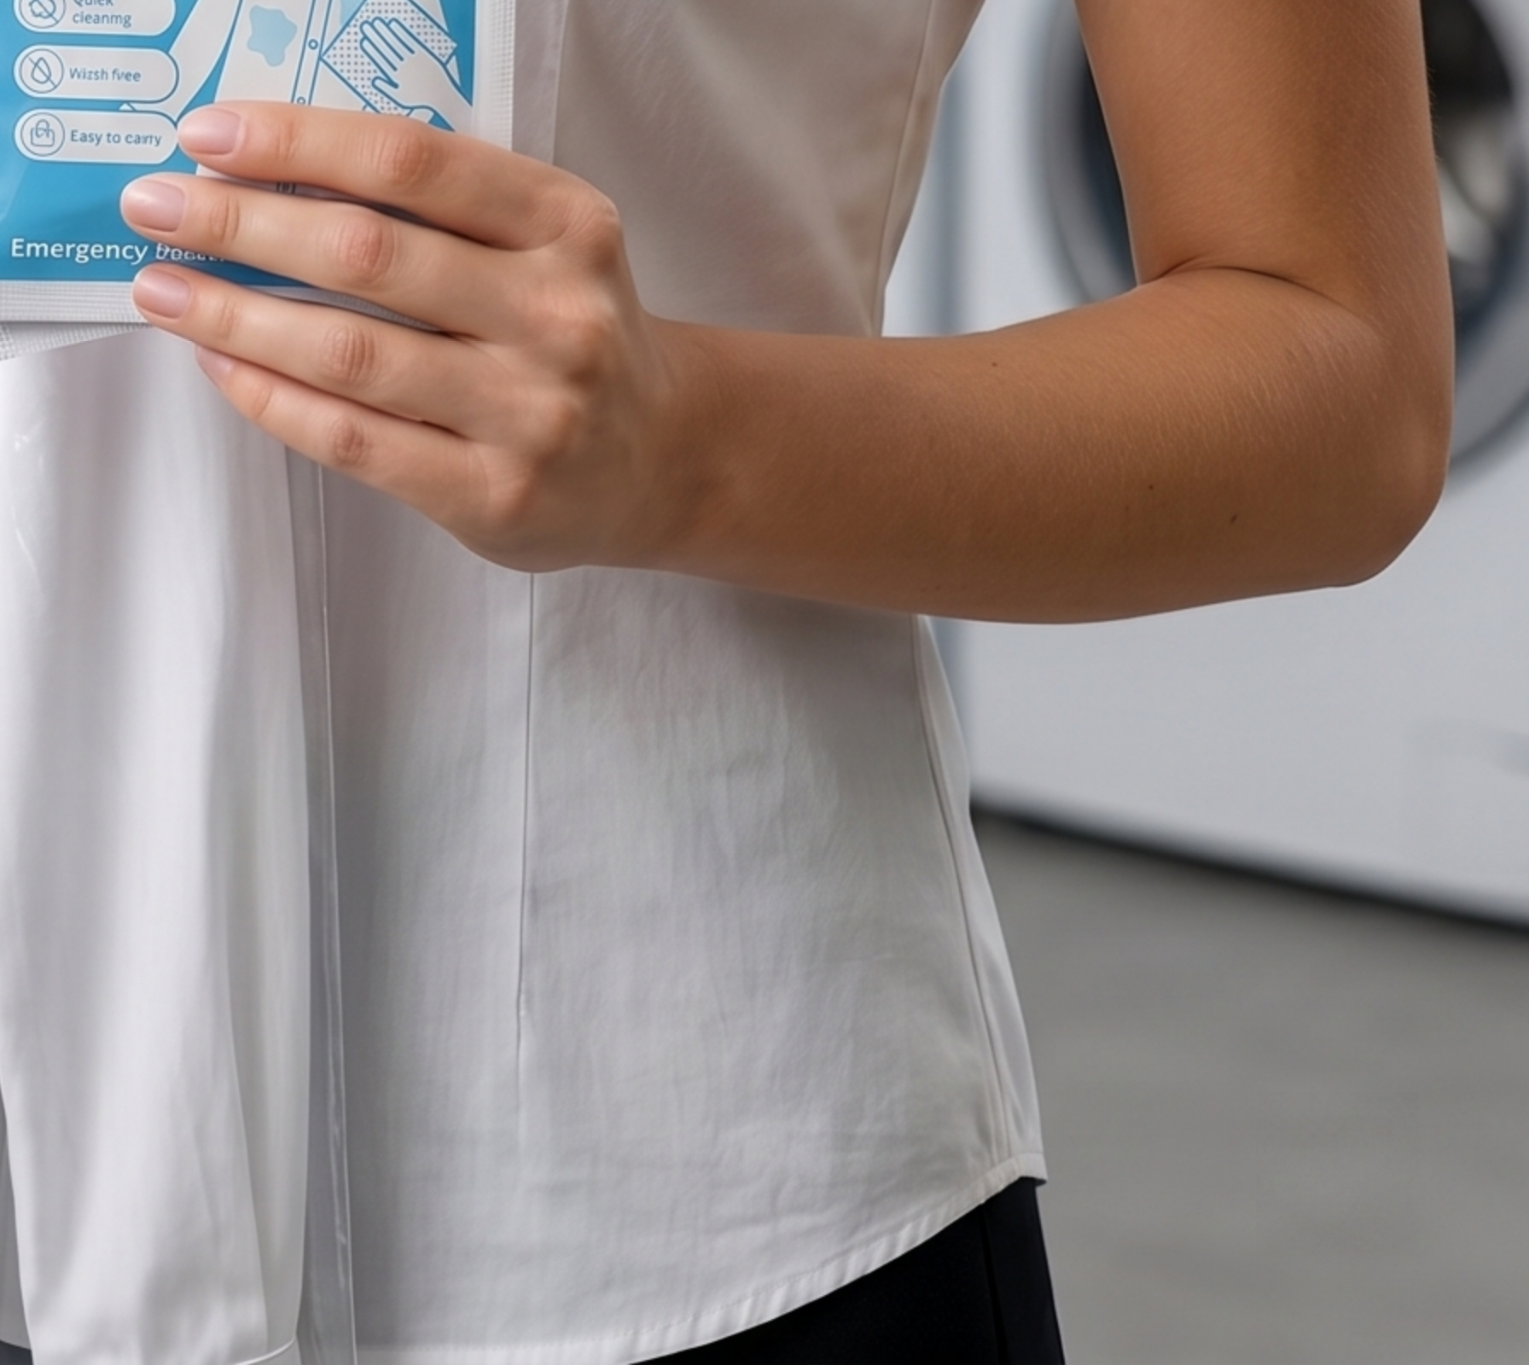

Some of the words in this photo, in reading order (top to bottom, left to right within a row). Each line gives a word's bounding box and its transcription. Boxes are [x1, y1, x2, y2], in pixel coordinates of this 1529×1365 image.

[70, 129, 103, 147] Easy
[106, 132, 122, 144] to
[11, 237, 149, 266] Emergency
